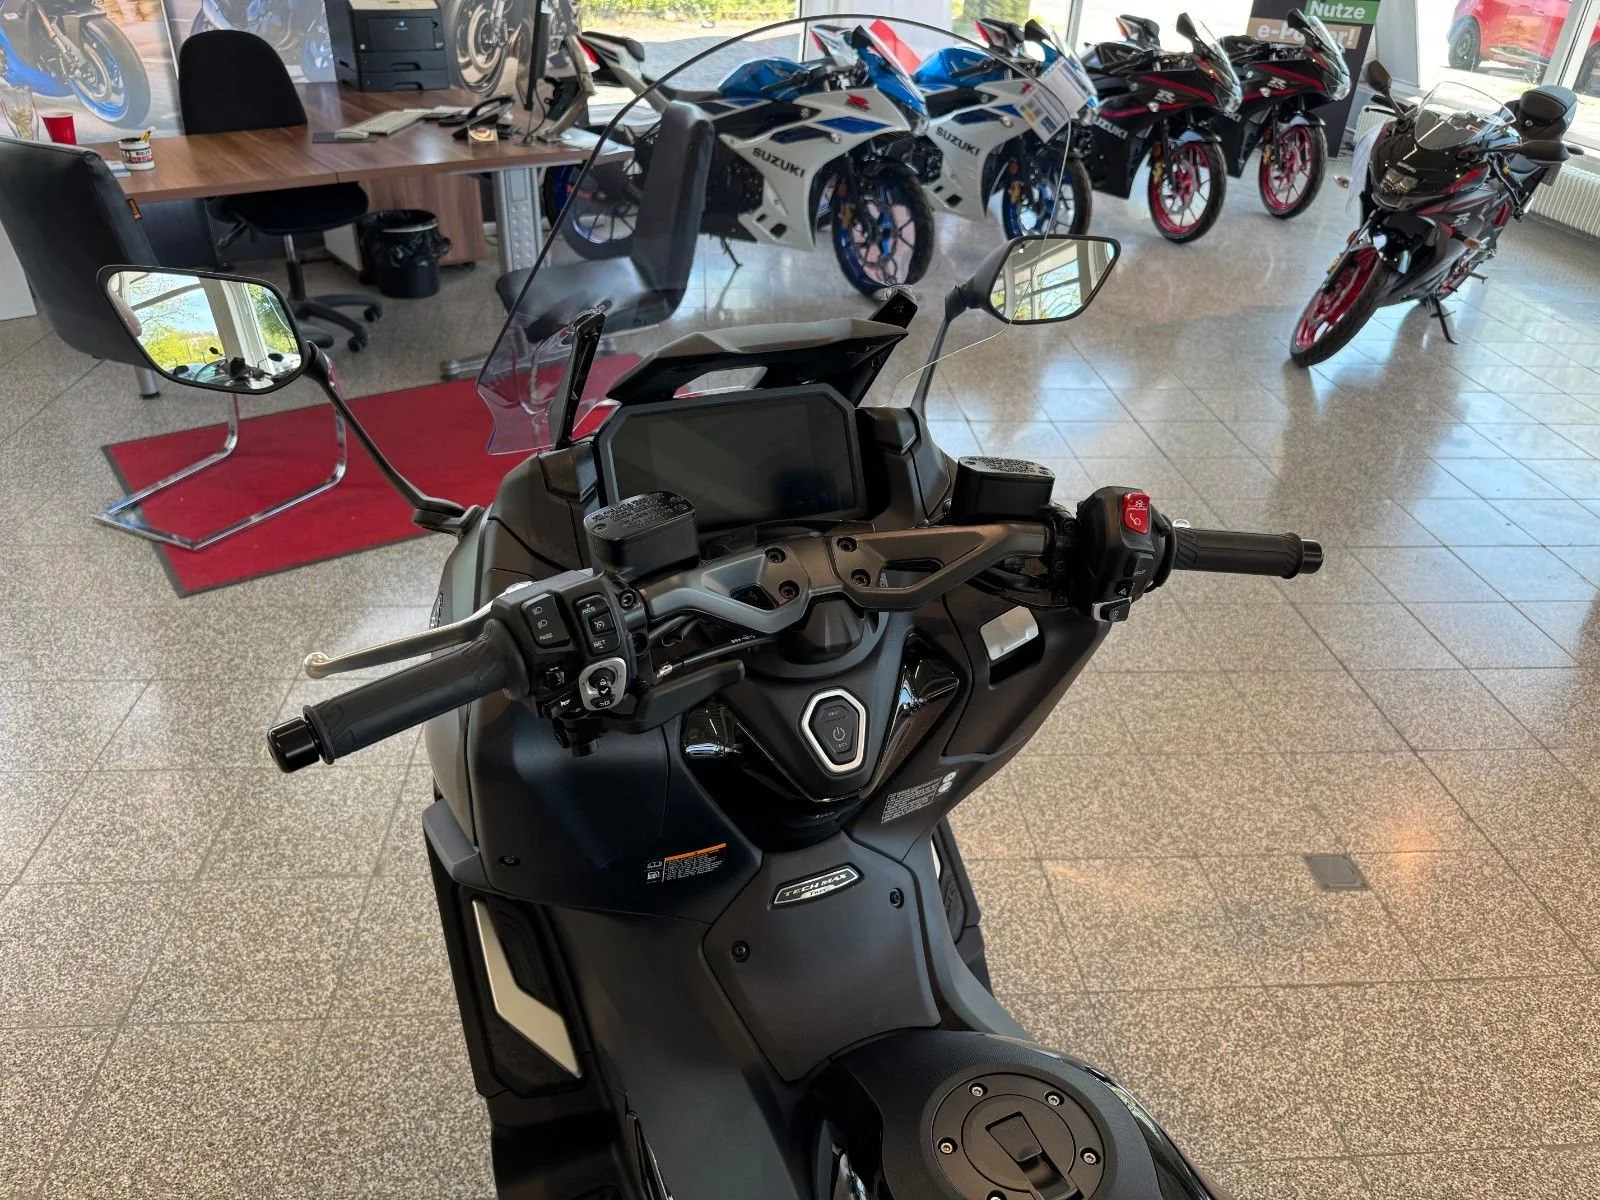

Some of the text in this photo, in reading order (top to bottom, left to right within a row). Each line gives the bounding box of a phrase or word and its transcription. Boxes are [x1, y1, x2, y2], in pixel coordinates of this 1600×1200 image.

[1310, 1, 1365, 19] Nutze
[1257, 21, 1356, 46] e-Poer!
[1092, 115, 1129, 140] UZUKI
[936, 126, 980, 156] SUZUKI
[752, 147, 805, 178] SUZUKI
[784, 873, 847, 897] TECH MAX
